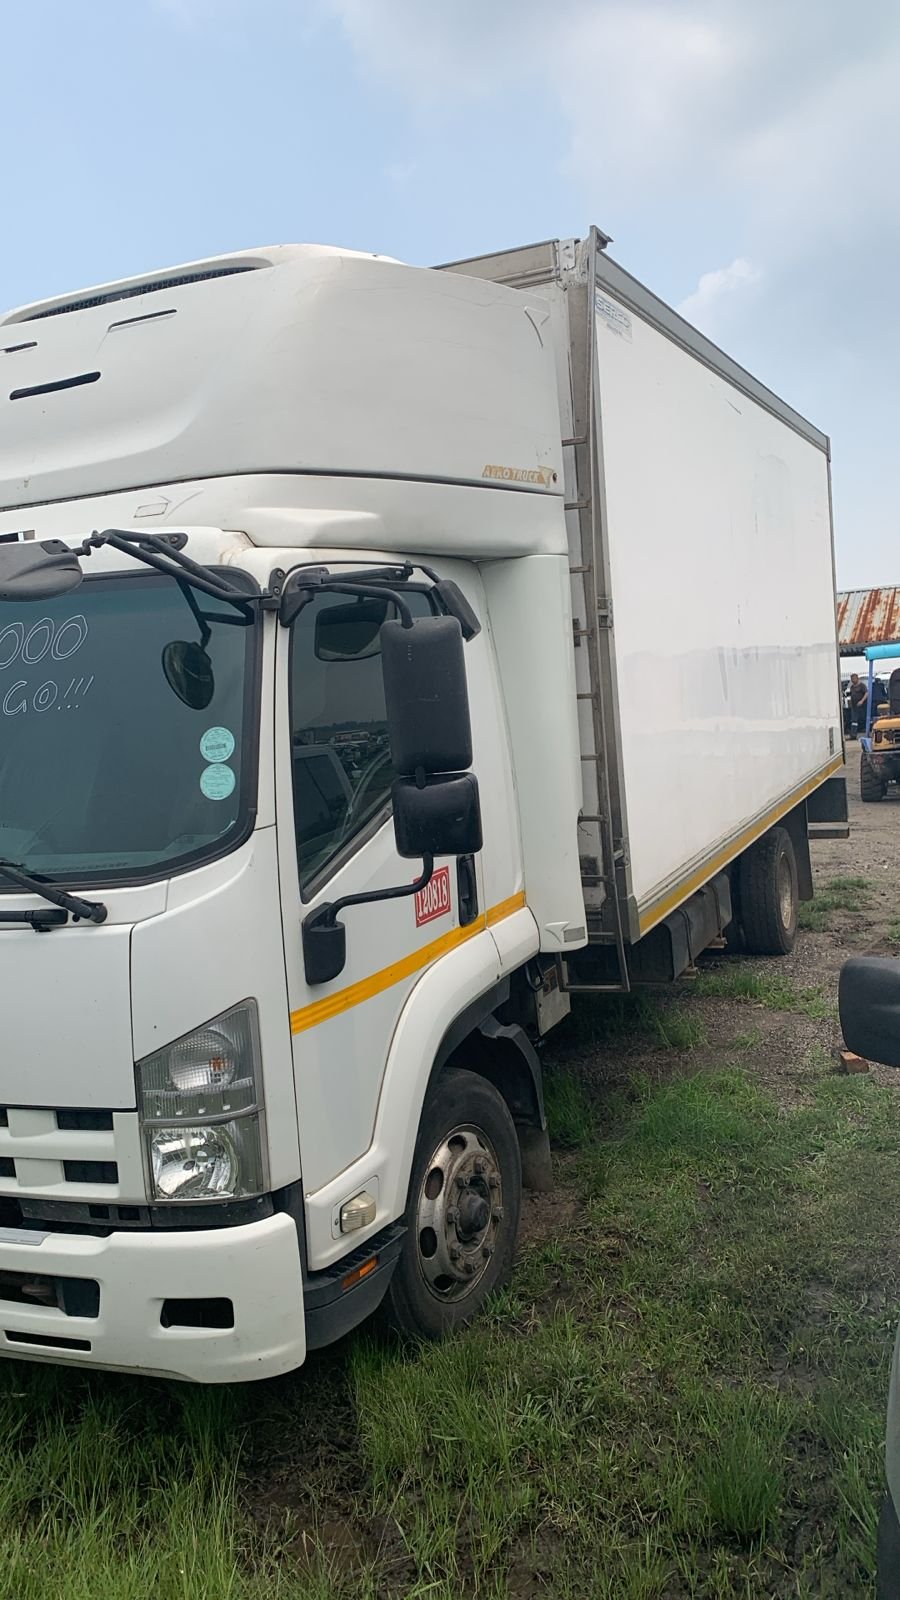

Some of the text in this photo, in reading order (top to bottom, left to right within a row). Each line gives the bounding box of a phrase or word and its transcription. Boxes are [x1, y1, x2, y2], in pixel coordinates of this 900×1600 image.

[483, 465, 540, 484] AERO TRUCK
[417, 875, 448, 918] 120818
